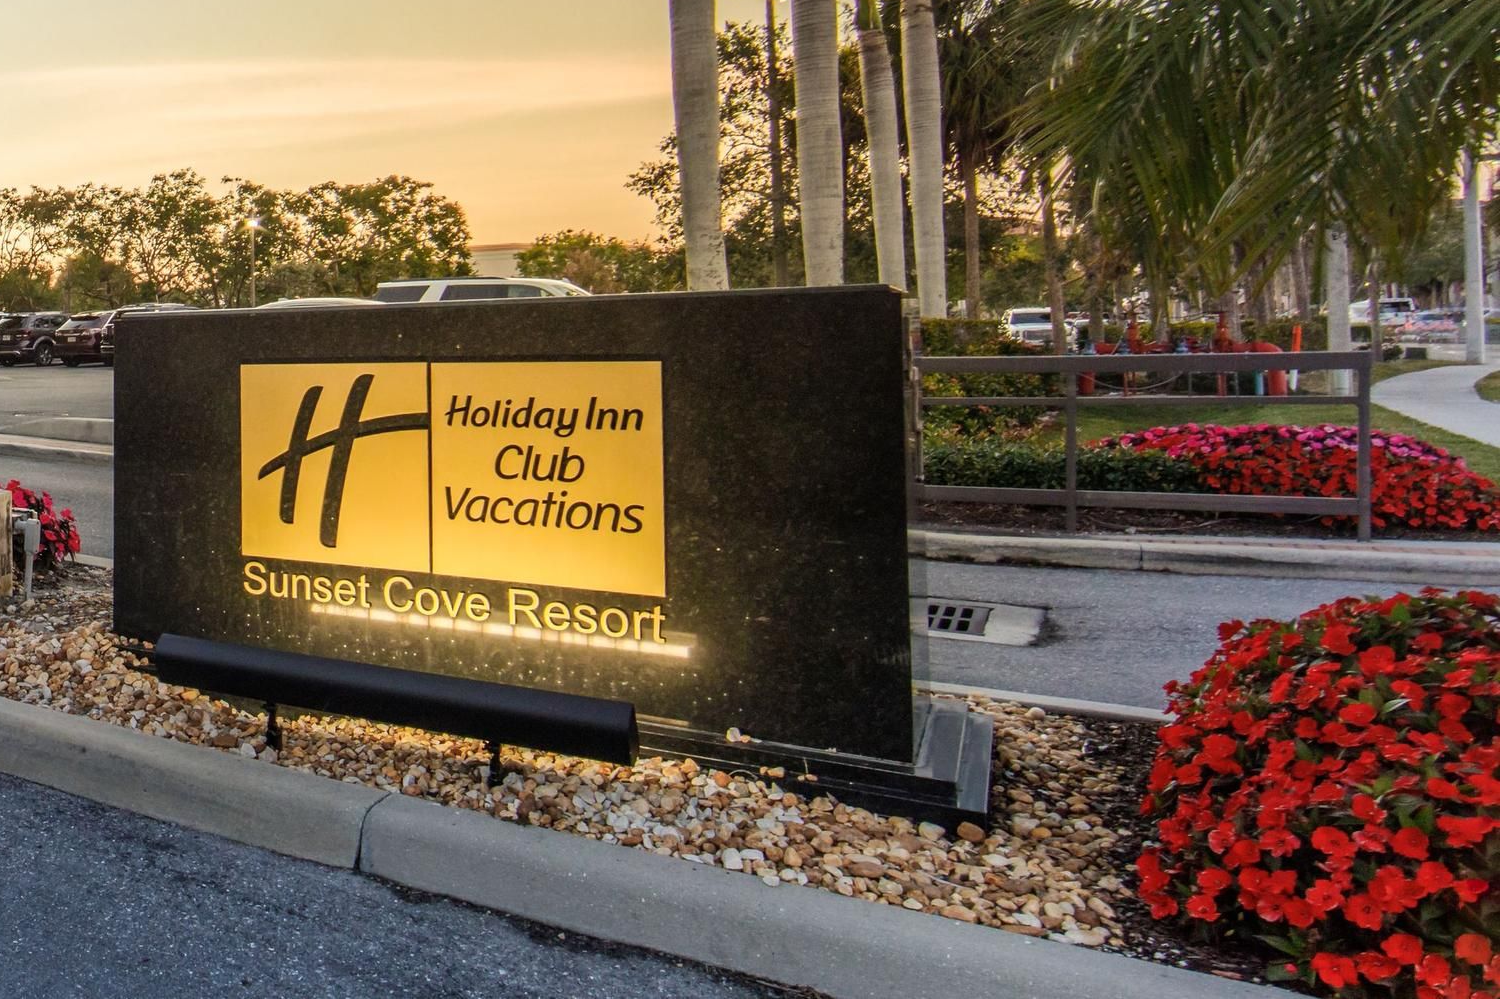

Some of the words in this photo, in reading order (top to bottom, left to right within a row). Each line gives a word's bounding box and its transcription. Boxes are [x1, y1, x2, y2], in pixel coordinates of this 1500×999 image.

[444, 394, 578, 437] Holiday
[585, 396, 644, 432] Inn
[494, 444, 585, 483] Club
[444, 485, 645, 534] Vacations
[243, 561, 370, 609] Sunset
[383, 576, 492, 622] Cove
[508, 587, 667, 644] Resort
